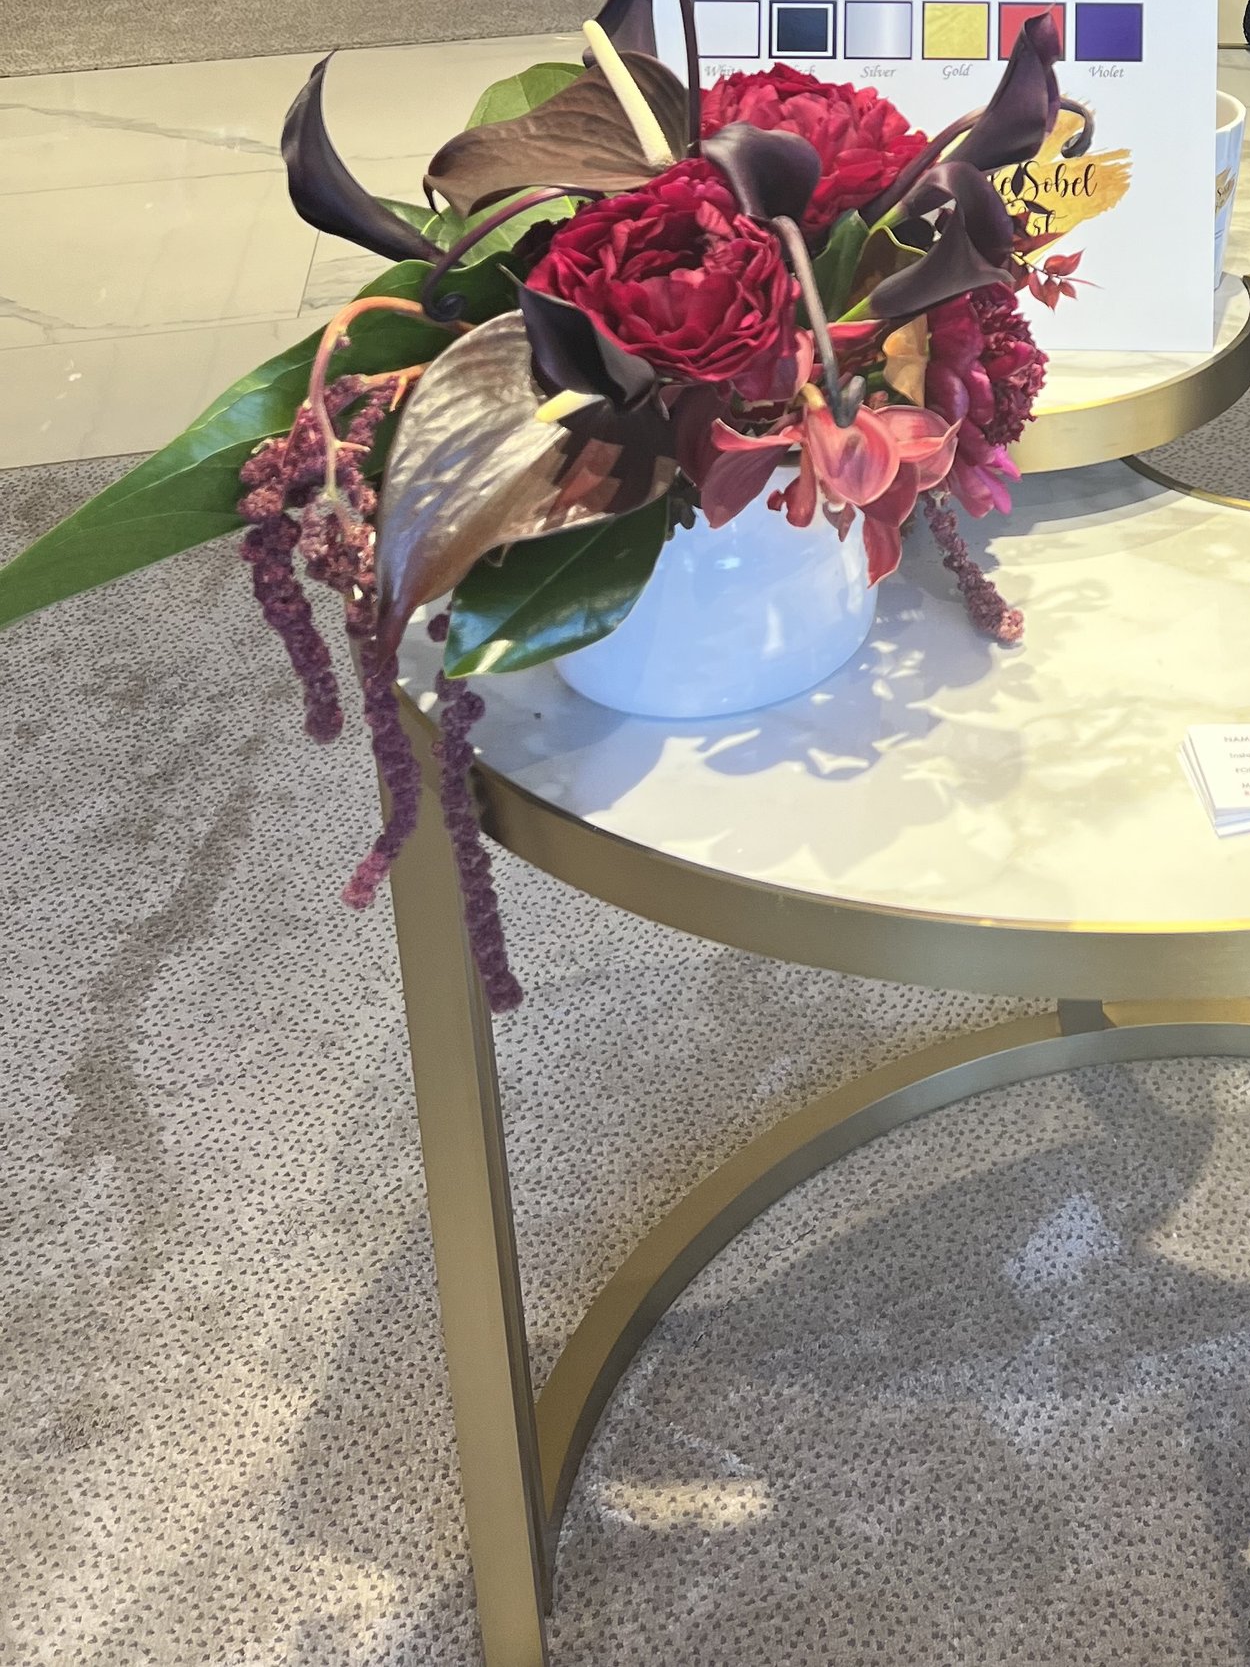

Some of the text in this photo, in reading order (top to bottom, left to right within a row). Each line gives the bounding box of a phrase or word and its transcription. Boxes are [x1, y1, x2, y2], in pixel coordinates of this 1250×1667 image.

[860, 65, 897, 79] Silver
[942, 64, 973, 80] Gold
[1088, 64, 1125, 79] Violet
[1022, 160, 1098, 202] Sobel
